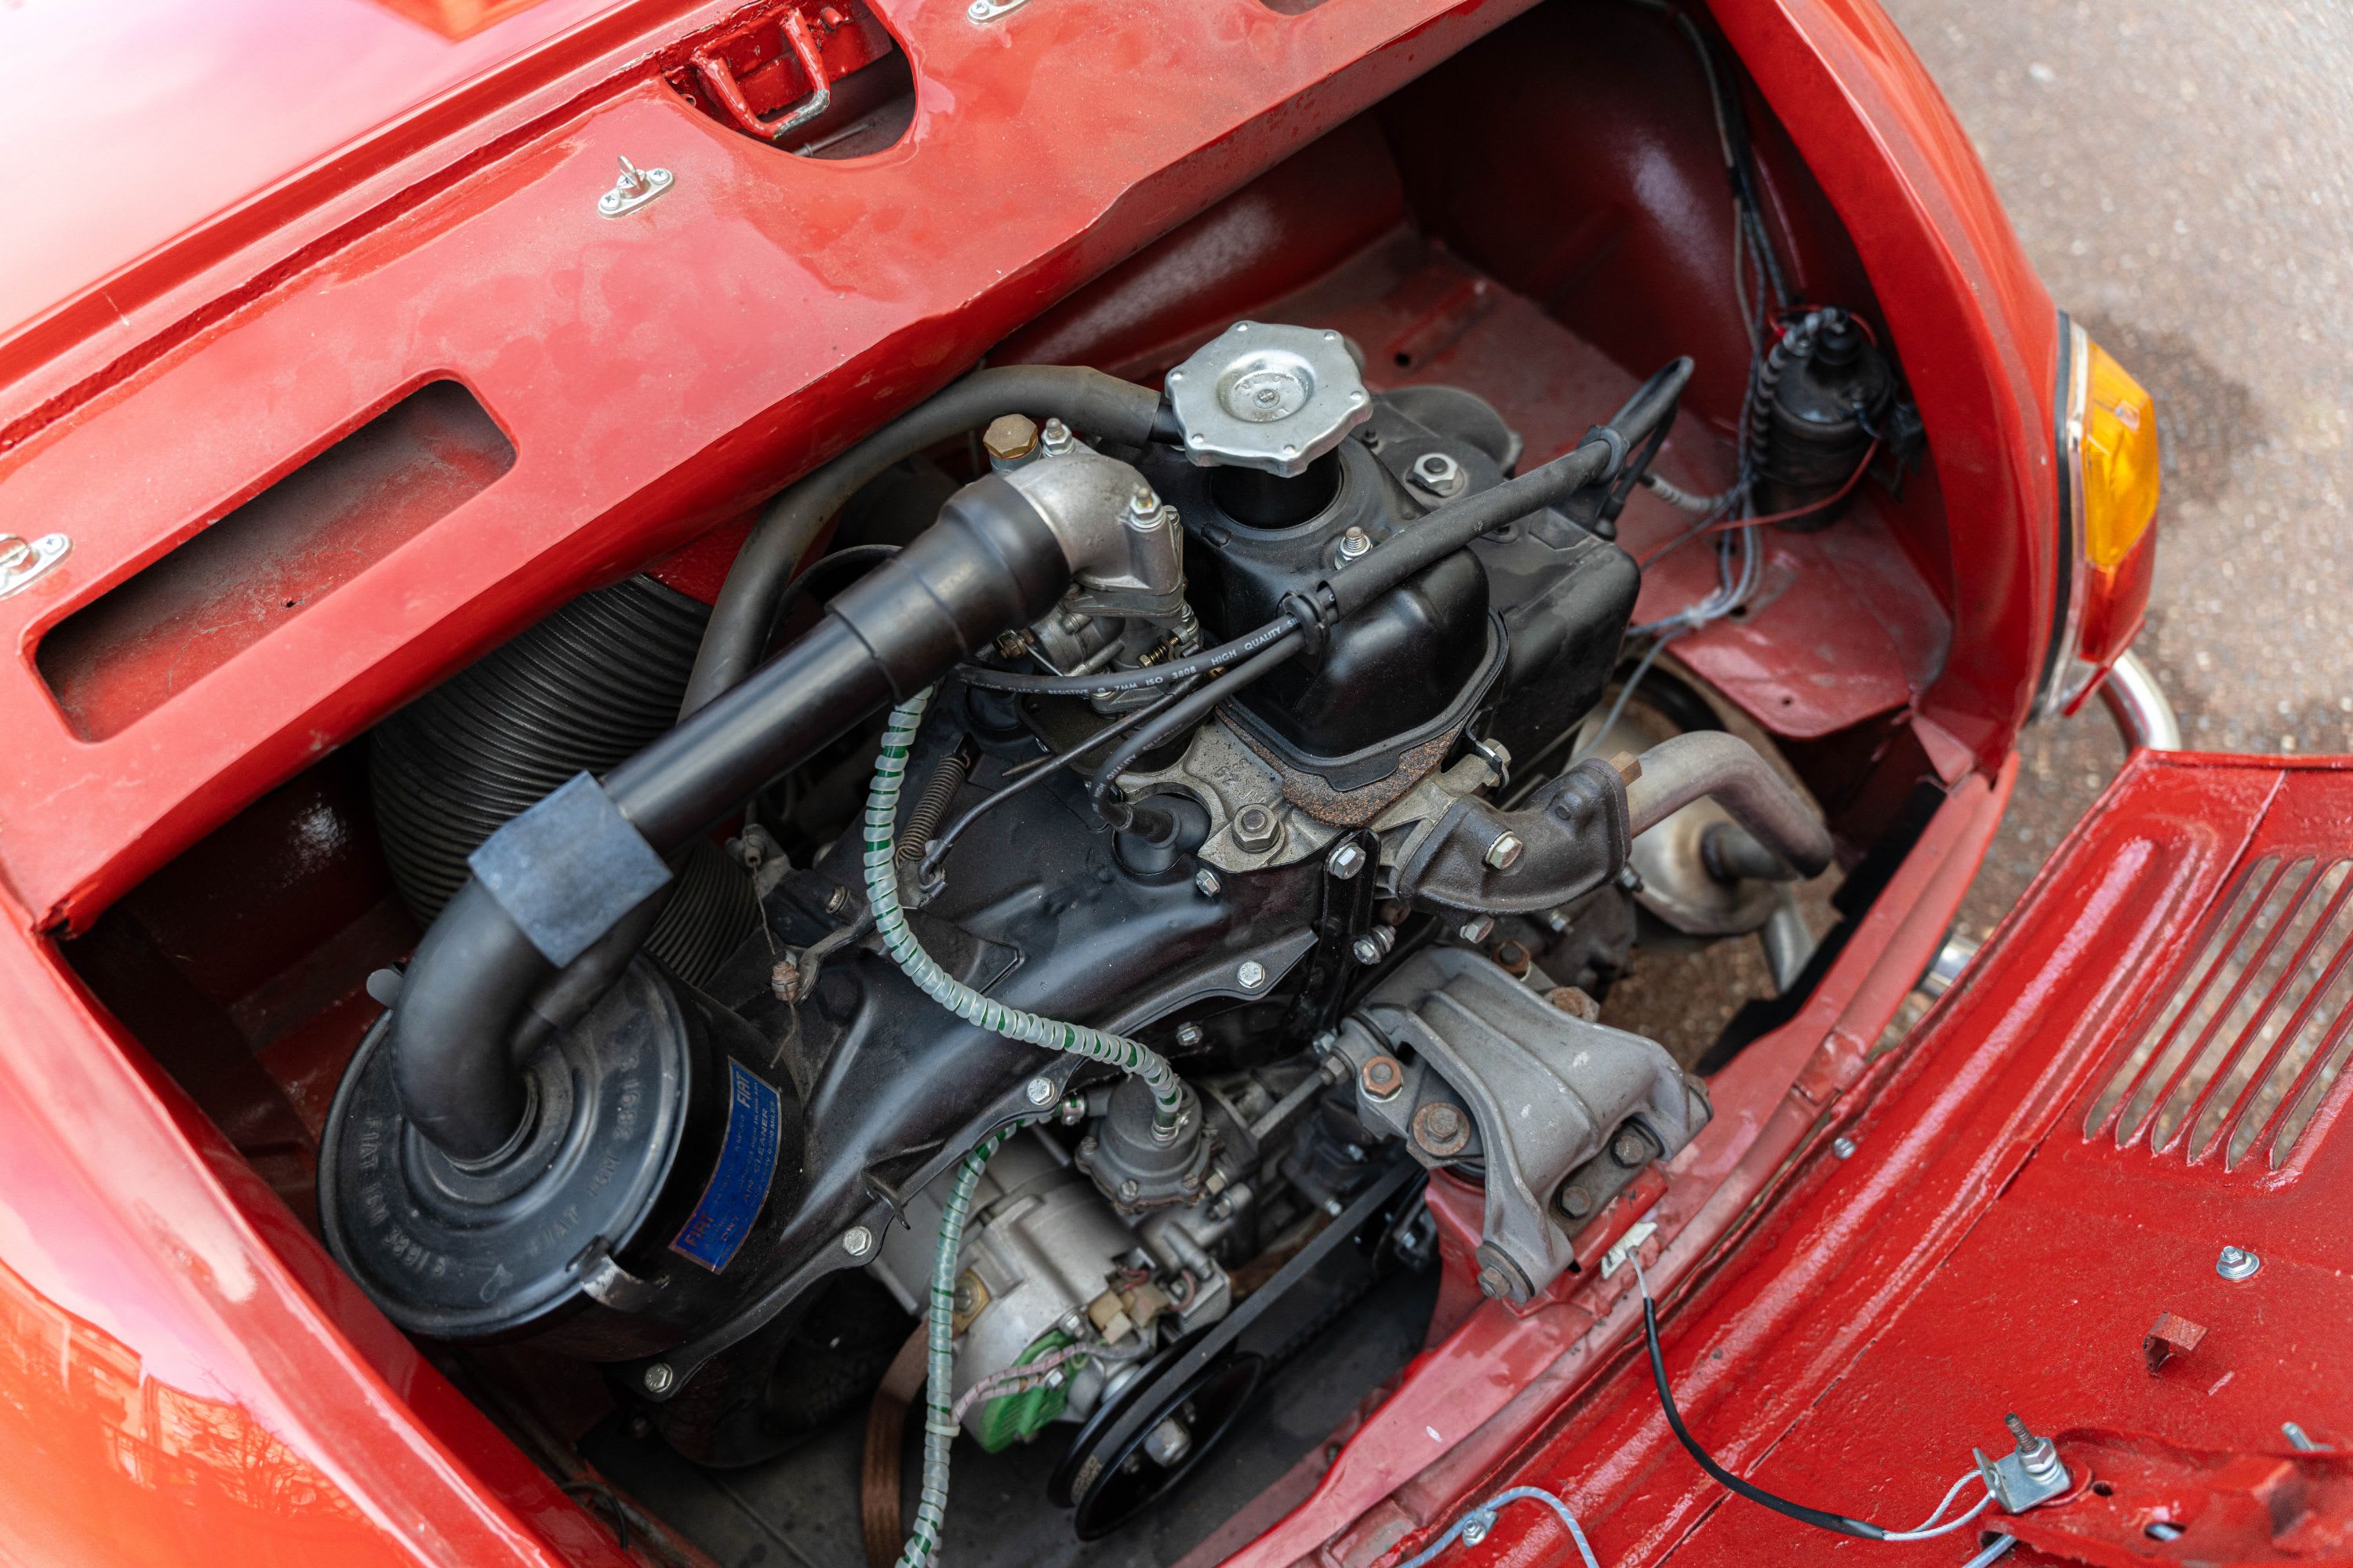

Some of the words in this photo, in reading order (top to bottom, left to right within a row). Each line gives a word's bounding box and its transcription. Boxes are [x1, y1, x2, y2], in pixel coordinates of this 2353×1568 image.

[1114, 682, 1138, 692] 7MM
[1145, 675, 1164, 686] ISO
[1172, 665, 1197, 680] 3808
[1210, 648, 1238, 666] HIGH
[1243, 625, 1282, 651] QUALITY
[1106, 754, 1136, 780] QUALITY
[736, 1071, 751, 1109] FIAT
[360, 1116, 383, 1169] FIAT
[753, 1107, 769, 1174] CLEANER
[525, 1204, 579, 1256] FIAT
[683, 1211, 715, 1247] FIAT
